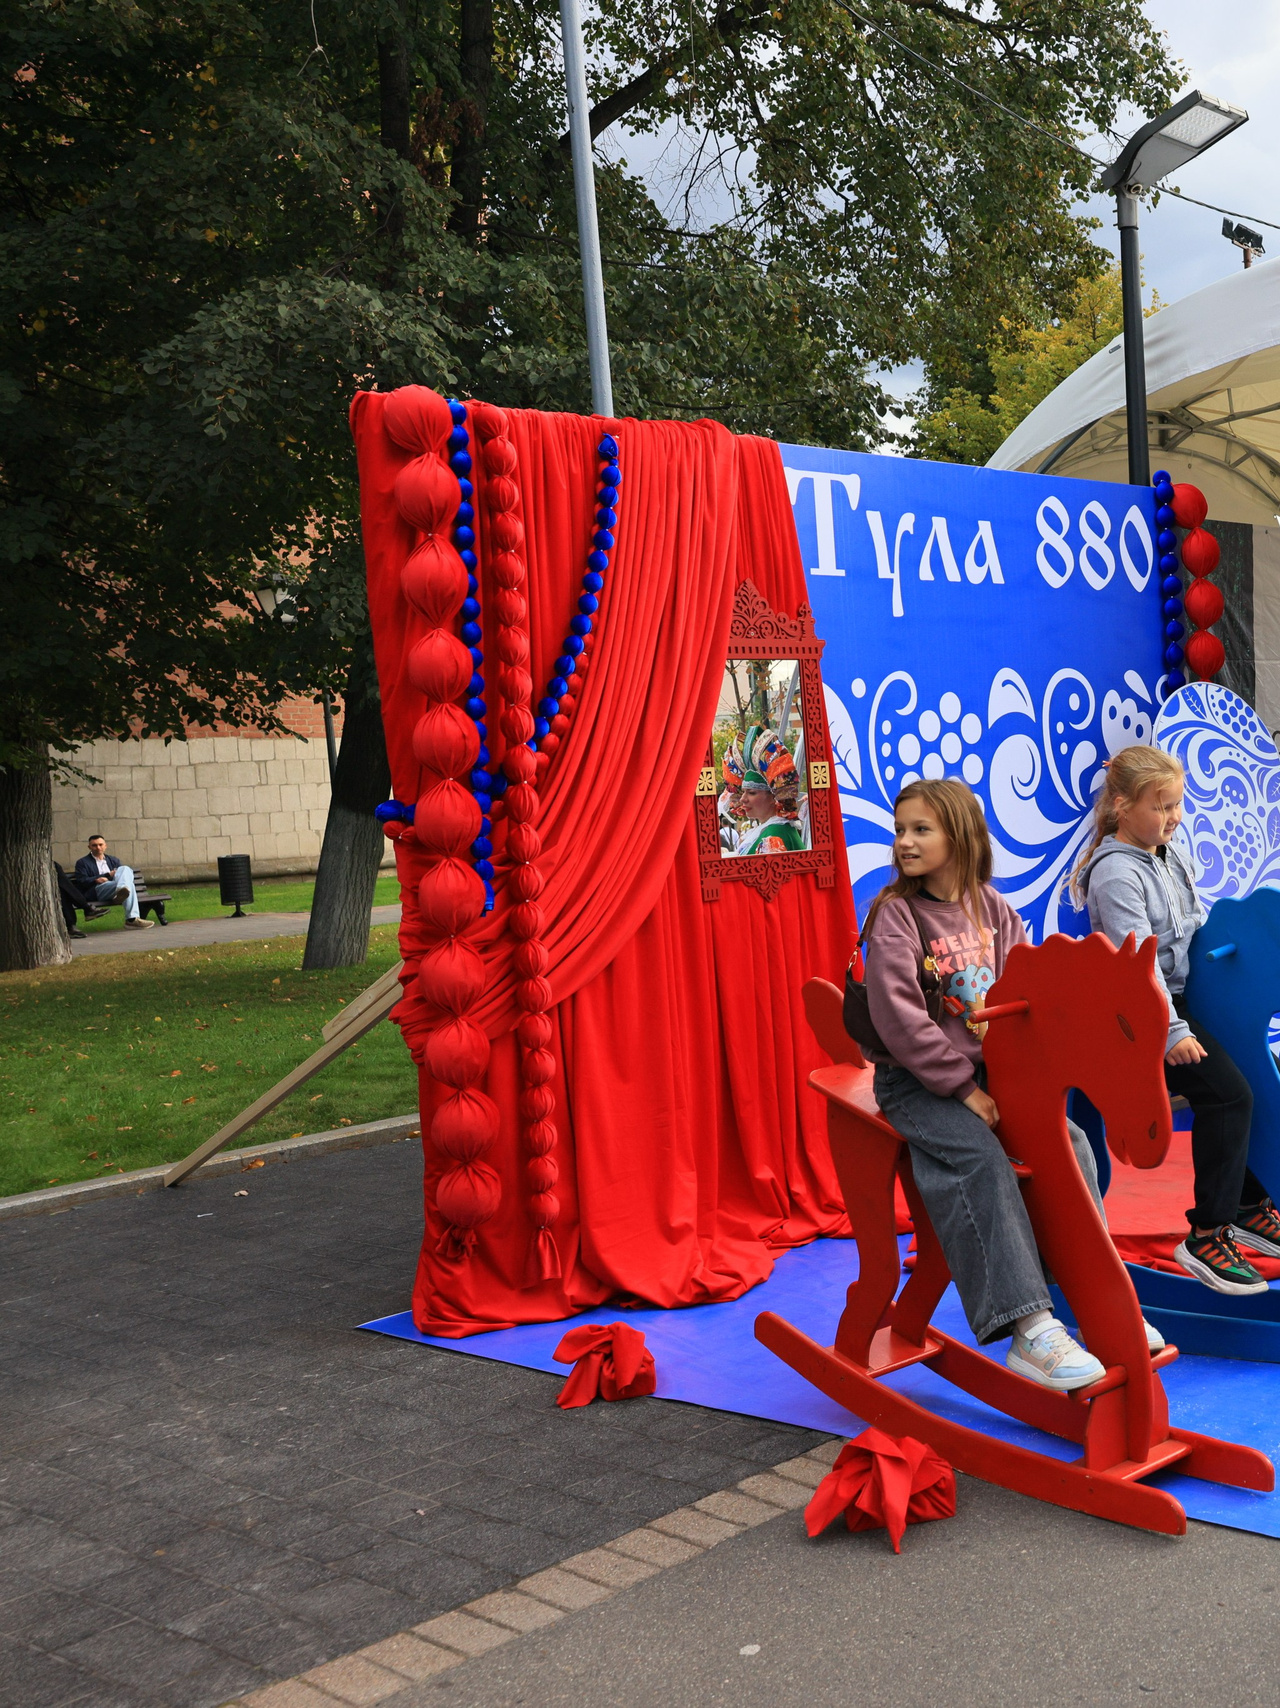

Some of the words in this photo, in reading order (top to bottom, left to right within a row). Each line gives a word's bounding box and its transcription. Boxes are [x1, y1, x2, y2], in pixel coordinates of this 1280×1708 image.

[785, 467, 1004, 617] Тула
[1036, 496, 1153, 592] 880
[930, 927, 994, 957] HELLO
